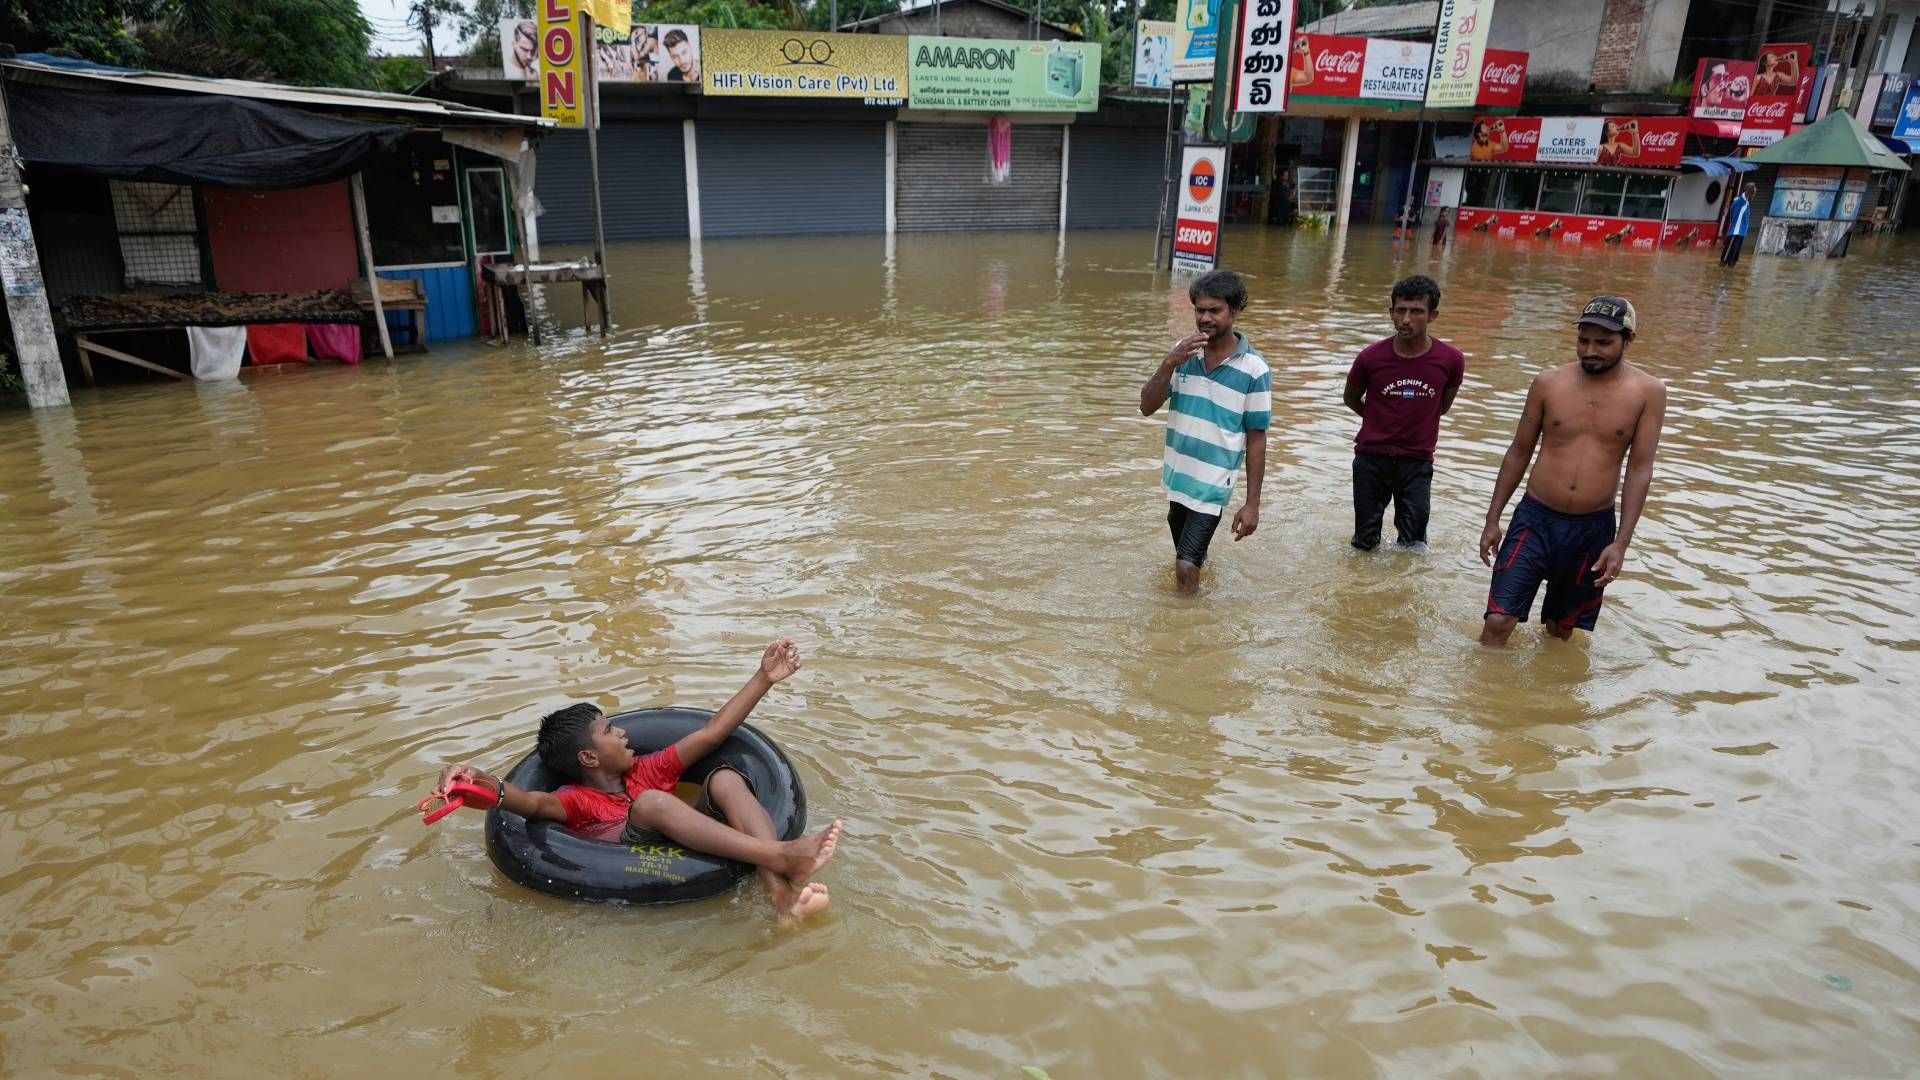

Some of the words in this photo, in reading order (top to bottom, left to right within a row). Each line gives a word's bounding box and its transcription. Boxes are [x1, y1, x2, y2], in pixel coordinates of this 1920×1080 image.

[1437, 22, 1452, 55] CLEAN
[915, 45, 1015, 71] AMARON
[1315, 48, 1363, 74] Coca-Cola
[1382, 66, 1425, 80] CATERS
[1433, 57, 1445, 79] DRY
[1482, 62, 1524, 85] Coca-Cola
[712, 73, 743, 88] HIFI
[748, 74, 792, 89] Vision
[797, 75, 831, 89] Care
[836, 76, 868, 92] (Pvt)
[1363, 79, 1411, 93] RESTAURANT
[1412, 82, 1417, 93] &
[913, 97, 945, 105] CHANDANA
[963, 98, 988, 106] BATTERY
[989, 99, 1011, 107] CENTER
[1747, 101, 1790, 118] Coca-Cola
[1508, 129, 1539, 144] Coca-Cola
[1552, 137, 1586, 147] CATERS
[1641, 131, 1680, 147] Coca-Cola
[1538, 147, 1575, 156] RESTAURANT
[1581, 148, 1597, 156] CAFE
[1195, 175, 1209, 186] IOC
[1185, 203, 1200, 214] Lanka
[1177, 226, 1212, 246] SERVO
[1583, 302, 1621, 317] OBEY
[1396, 378, 1423, 387] DENIM
[625, 866, 649, 875] MADE
[651, 869, 661, 877] IN
